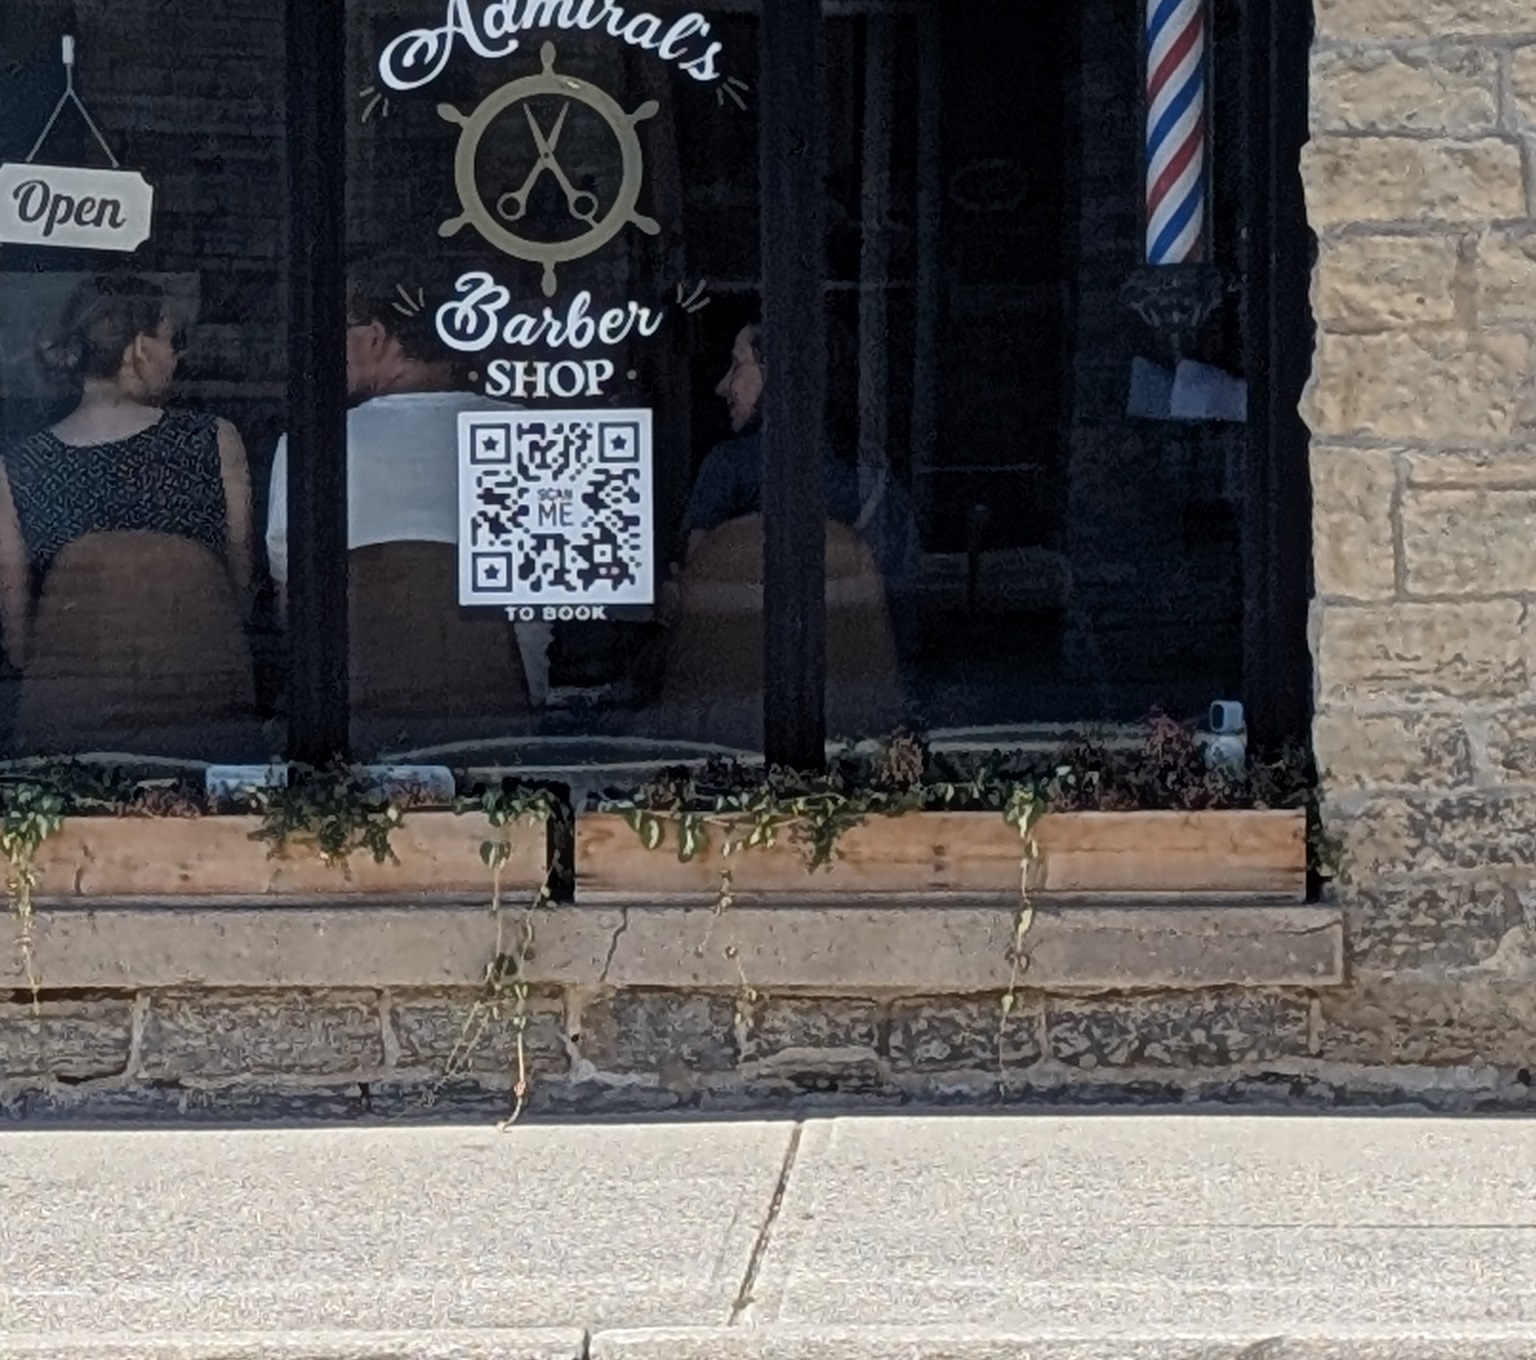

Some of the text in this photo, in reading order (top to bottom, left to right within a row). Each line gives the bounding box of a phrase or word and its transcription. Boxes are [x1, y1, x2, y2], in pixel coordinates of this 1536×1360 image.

[13, 180, 126, 237] Open
[436, 271, 663, 351] Barber
[485, 359, 614, 398] SHOP
[538, 502, 575, 527] ME
[505, 606, 608, 621] TO BOOK
